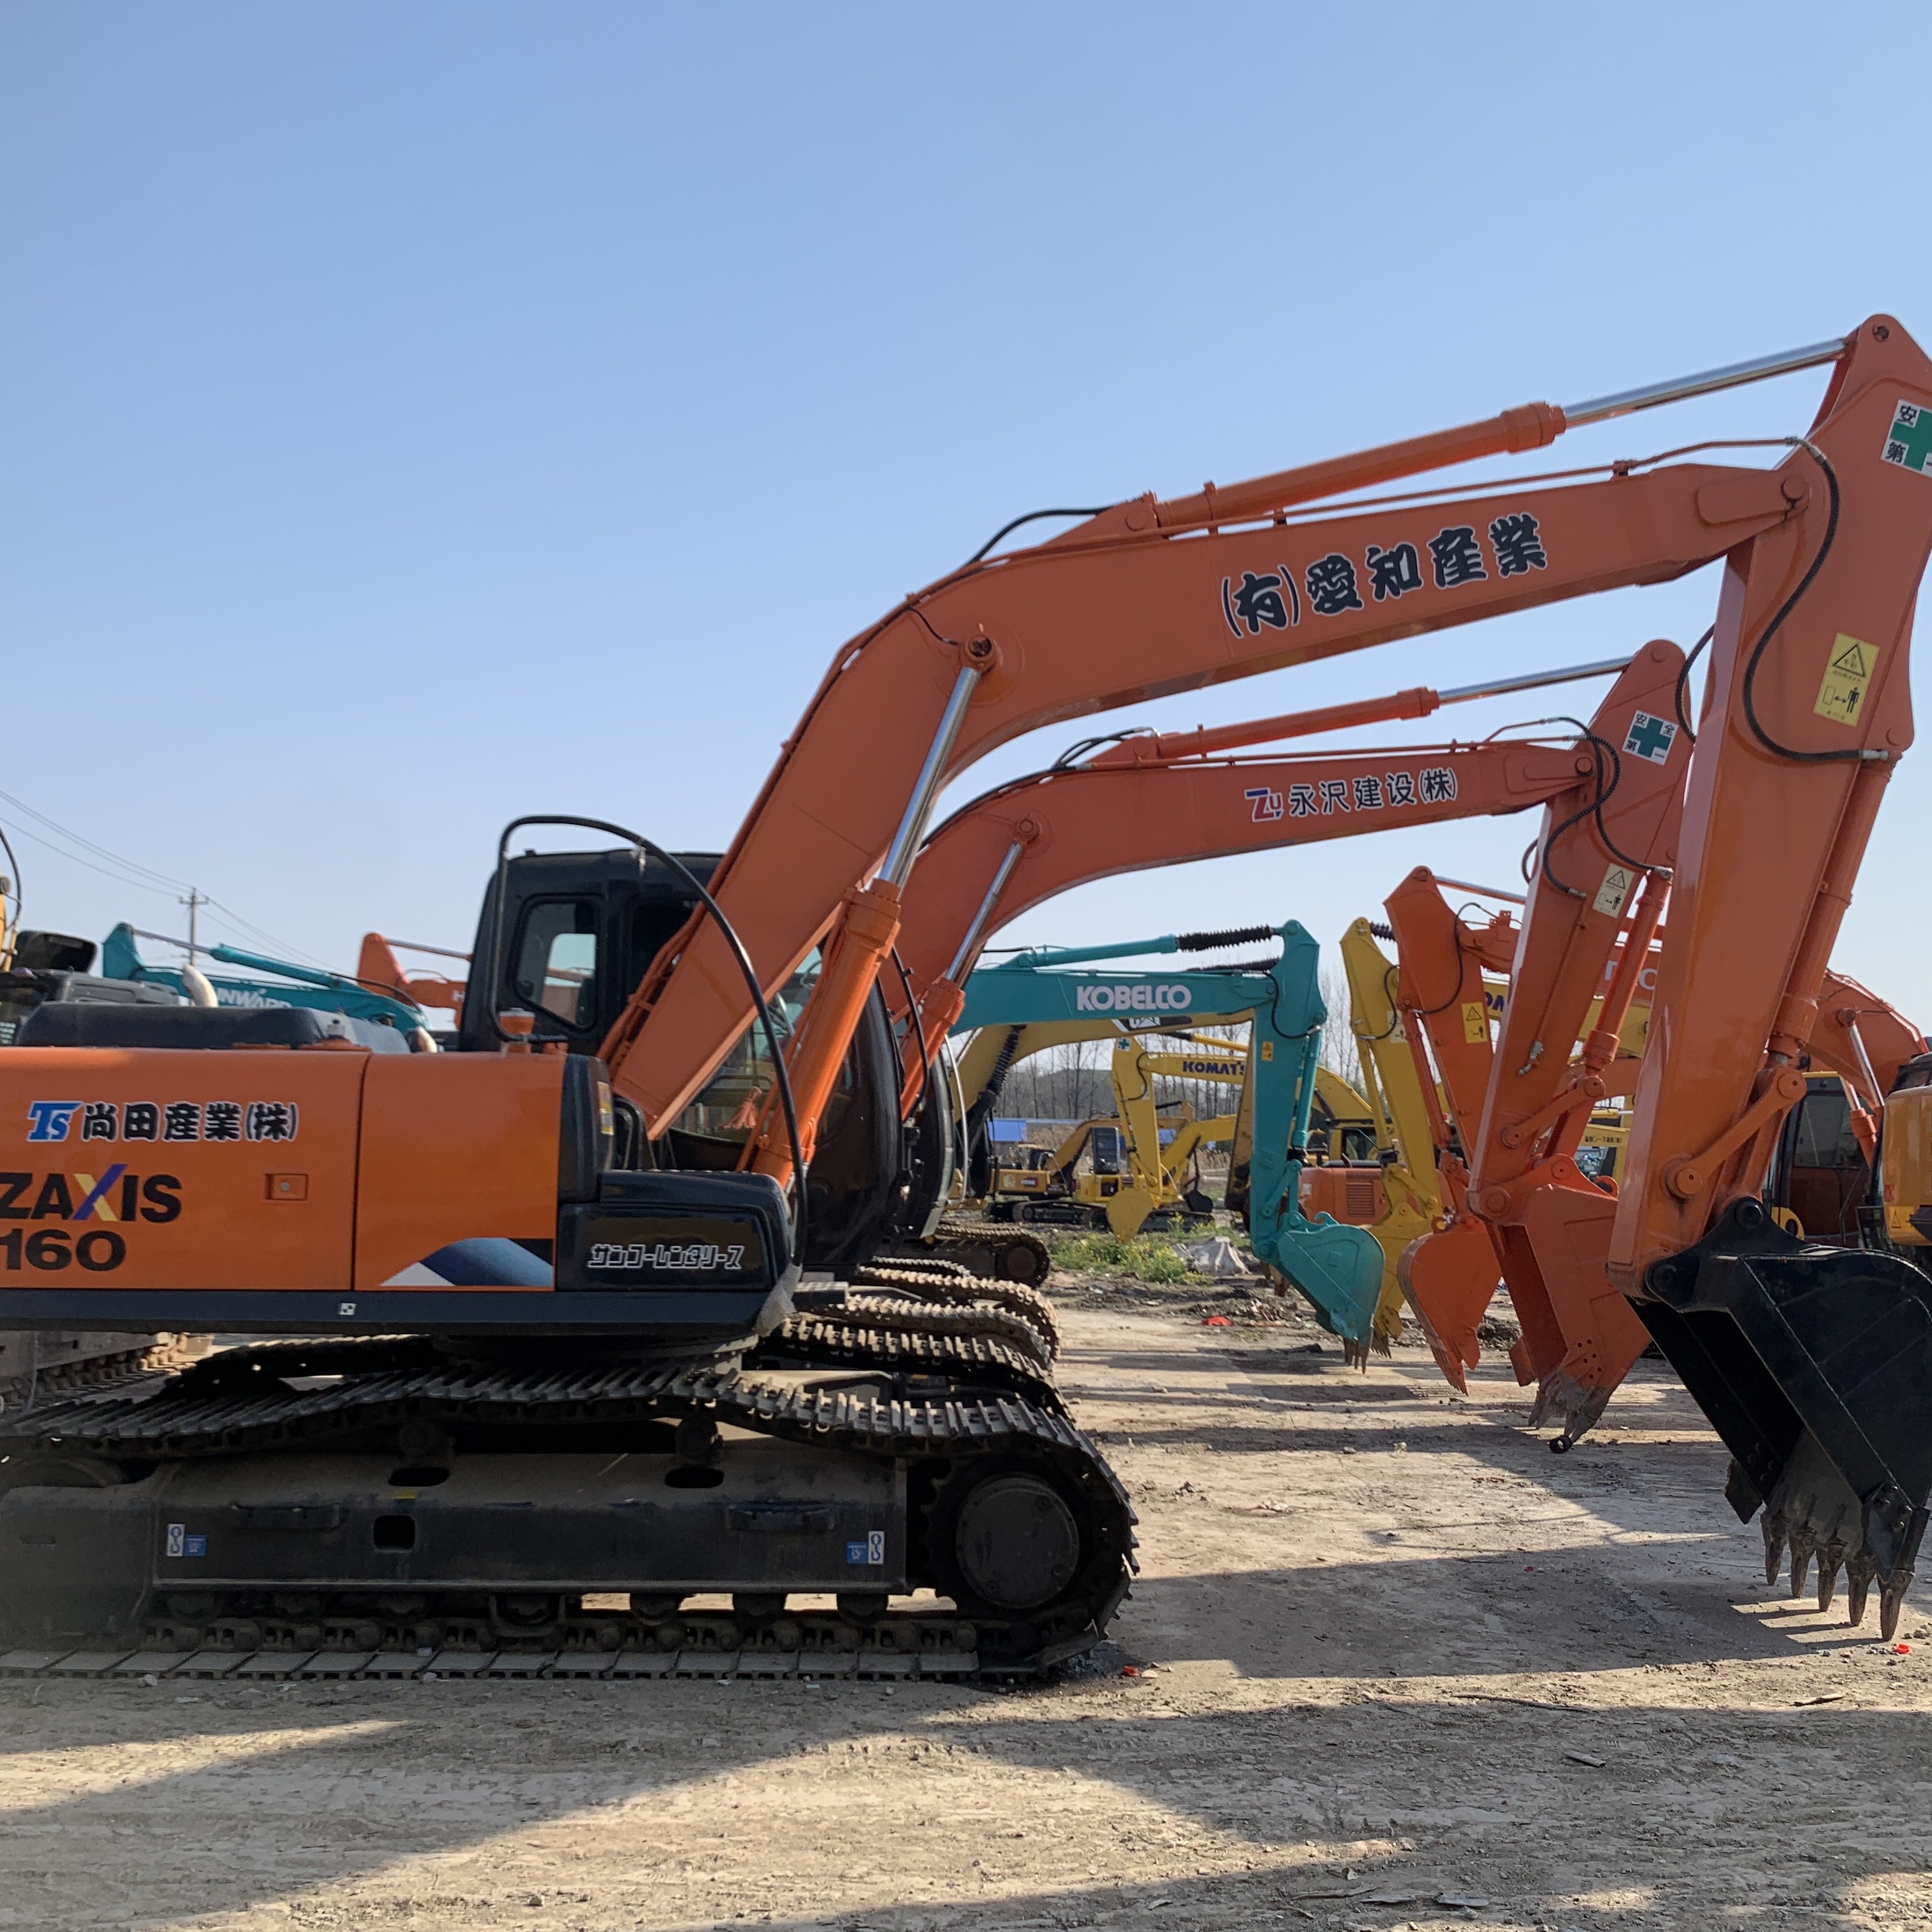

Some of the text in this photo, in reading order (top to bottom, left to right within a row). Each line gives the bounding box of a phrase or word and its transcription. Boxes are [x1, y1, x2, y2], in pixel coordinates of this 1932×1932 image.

[1077, 985, 1192, 1011] KOBELCO
[0, 1163, 182, 1223] ZAXIS
[0, 1229, 126, 1271] 160
